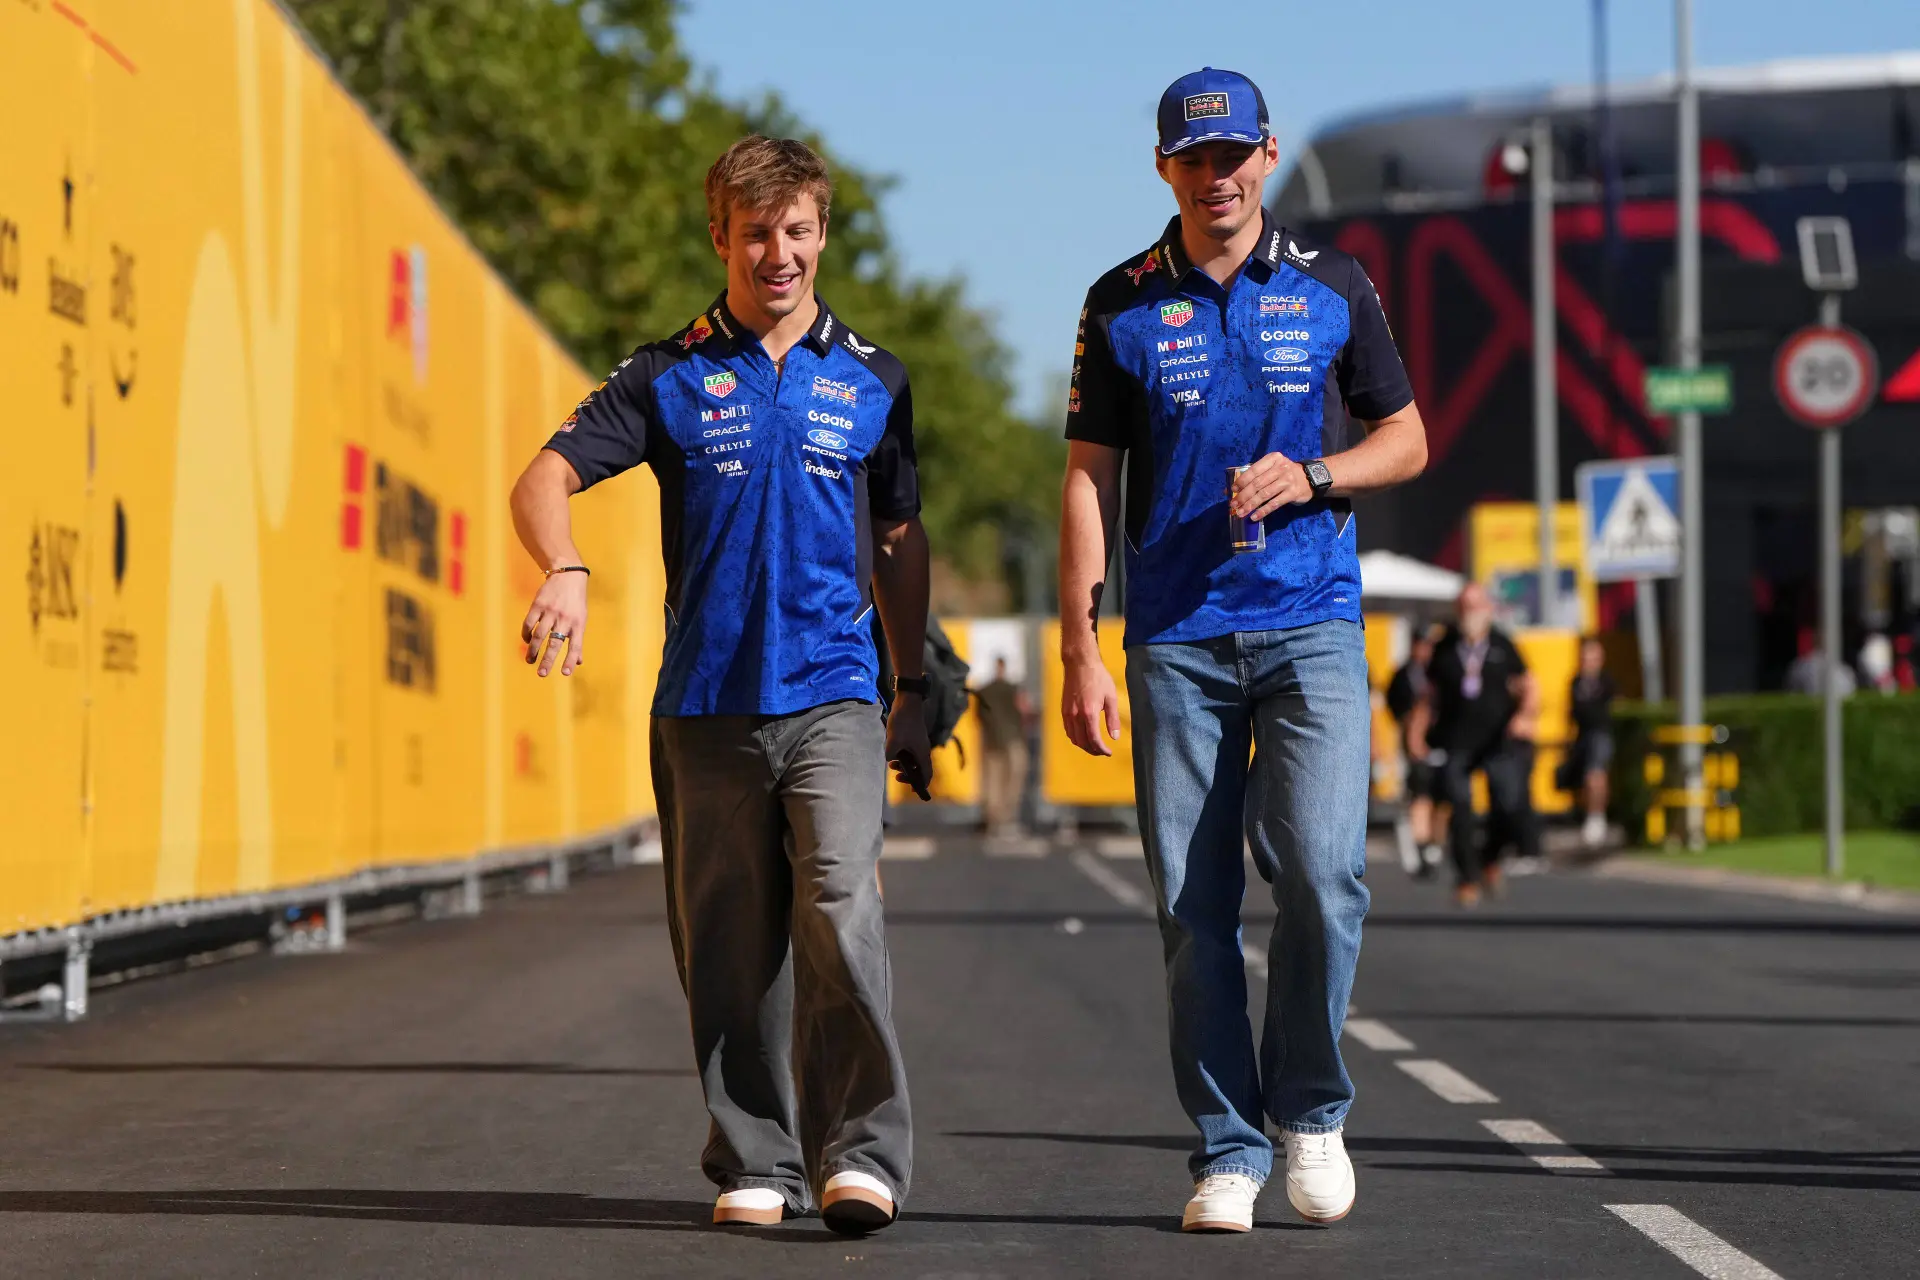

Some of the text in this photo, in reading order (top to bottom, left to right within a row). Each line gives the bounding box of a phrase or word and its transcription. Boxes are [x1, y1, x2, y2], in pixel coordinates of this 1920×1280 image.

[1189, 96, 1223, 105] ORACLE
[1260, 295, 1307, 303] ORACLE
[1163, 302, 1190, 314] TAG
[1162, 309, 1193, 327] HEUER
[1157, 336, 1193, 352] Mobil
[1159, 353, 1208, 368] ORACLE
[1272, 349, 1300, 361] Ford
[706, 373, 733, 385] TAG
[1161, 369, 1210, 384] CARLYLE
[706, 381, 737, 397] HEUER
[814, 375, 858, 394] ORACLE
[1266, 381, 1310, 393] indeed
[811, 391, 857, 408] RACING
[1169, 389, 1201, 404] VISA
[701, 406, 736, 422] Mobil
[702, 424, 751, 438] ORACLE
[705, 439, 752, 454] CARLYLE
[815, 431, 840, 448] Ford
[801, 444, 848, 461] RACING
[713, 460, 743, 474] VISA
[726, 470, 749, 478] INFINITE
[802, 459, 842, 480] indeed
